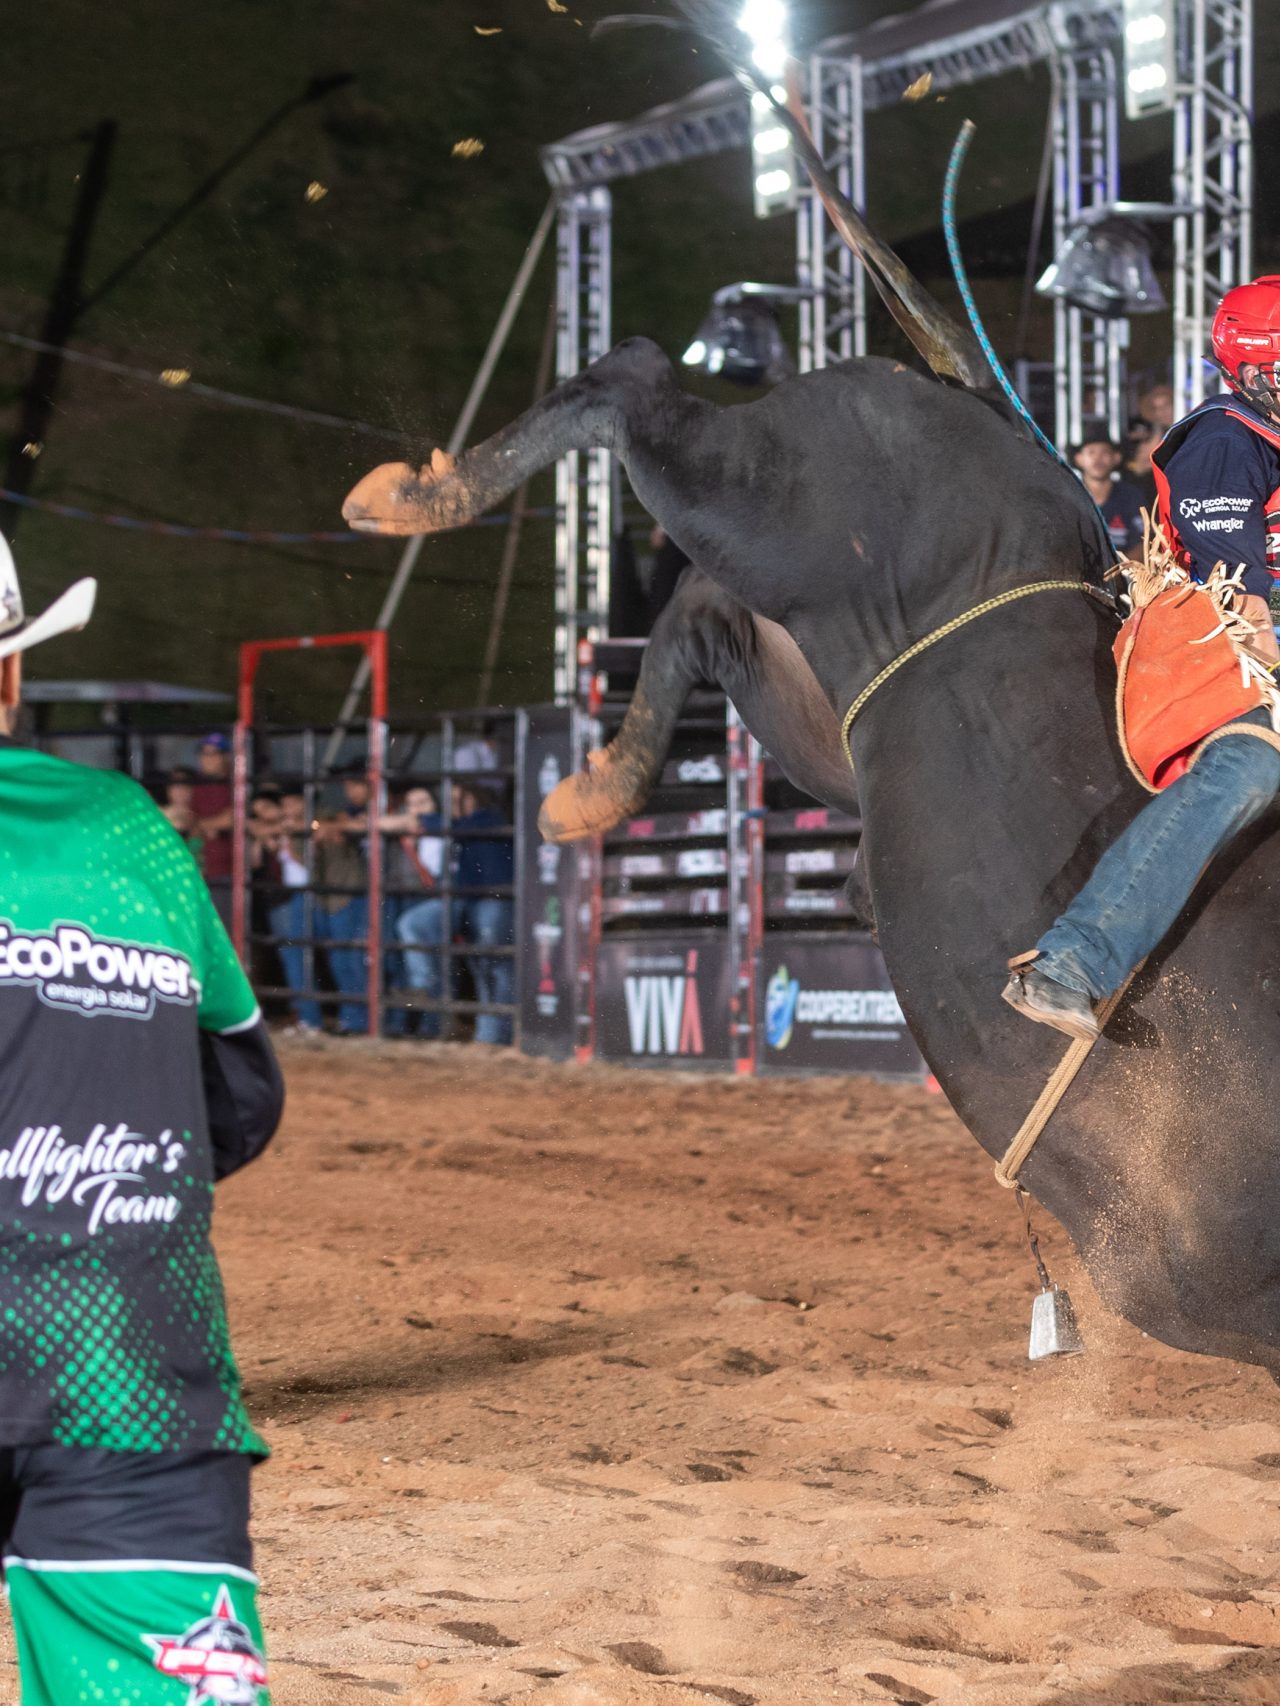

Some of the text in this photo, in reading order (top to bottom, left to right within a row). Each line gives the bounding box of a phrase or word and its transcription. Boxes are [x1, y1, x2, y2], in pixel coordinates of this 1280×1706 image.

[1202, 496, 1254, 509] EcoPower
[1192, 517, 1245, 533] Wrangler
[46, 979, 148, 1010] energia solar
[73, 1172, 182, 1235] Team
